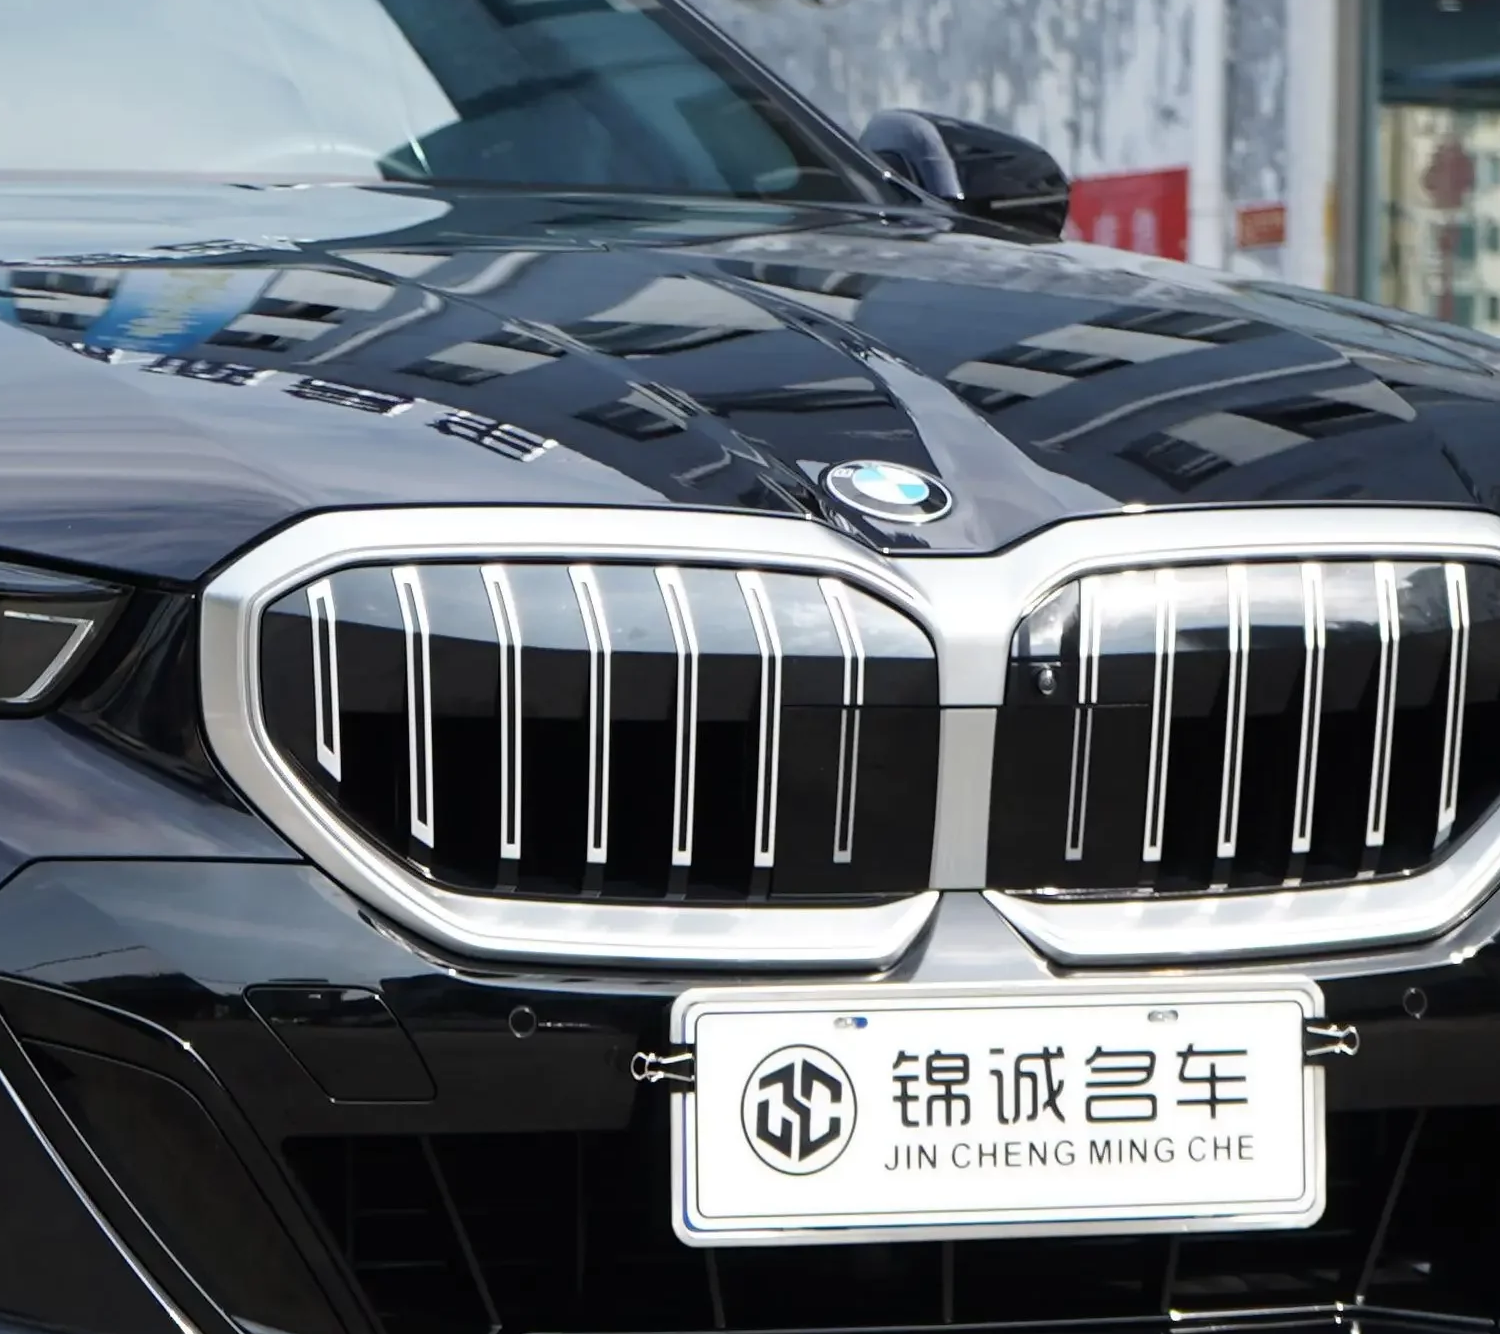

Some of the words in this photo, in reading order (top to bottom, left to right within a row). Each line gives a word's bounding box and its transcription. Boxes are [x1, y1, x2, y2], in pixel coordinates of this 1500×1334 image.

[892, 1043, 1248, 1128] 锦诚名车
[883, 1144, 938, 1171] JIN
[951, 1141, 1077, 1168] CHENG
[1089, 1138, 1175, 1164] MING
[1187, 1135, 1255, 1160] CHE
